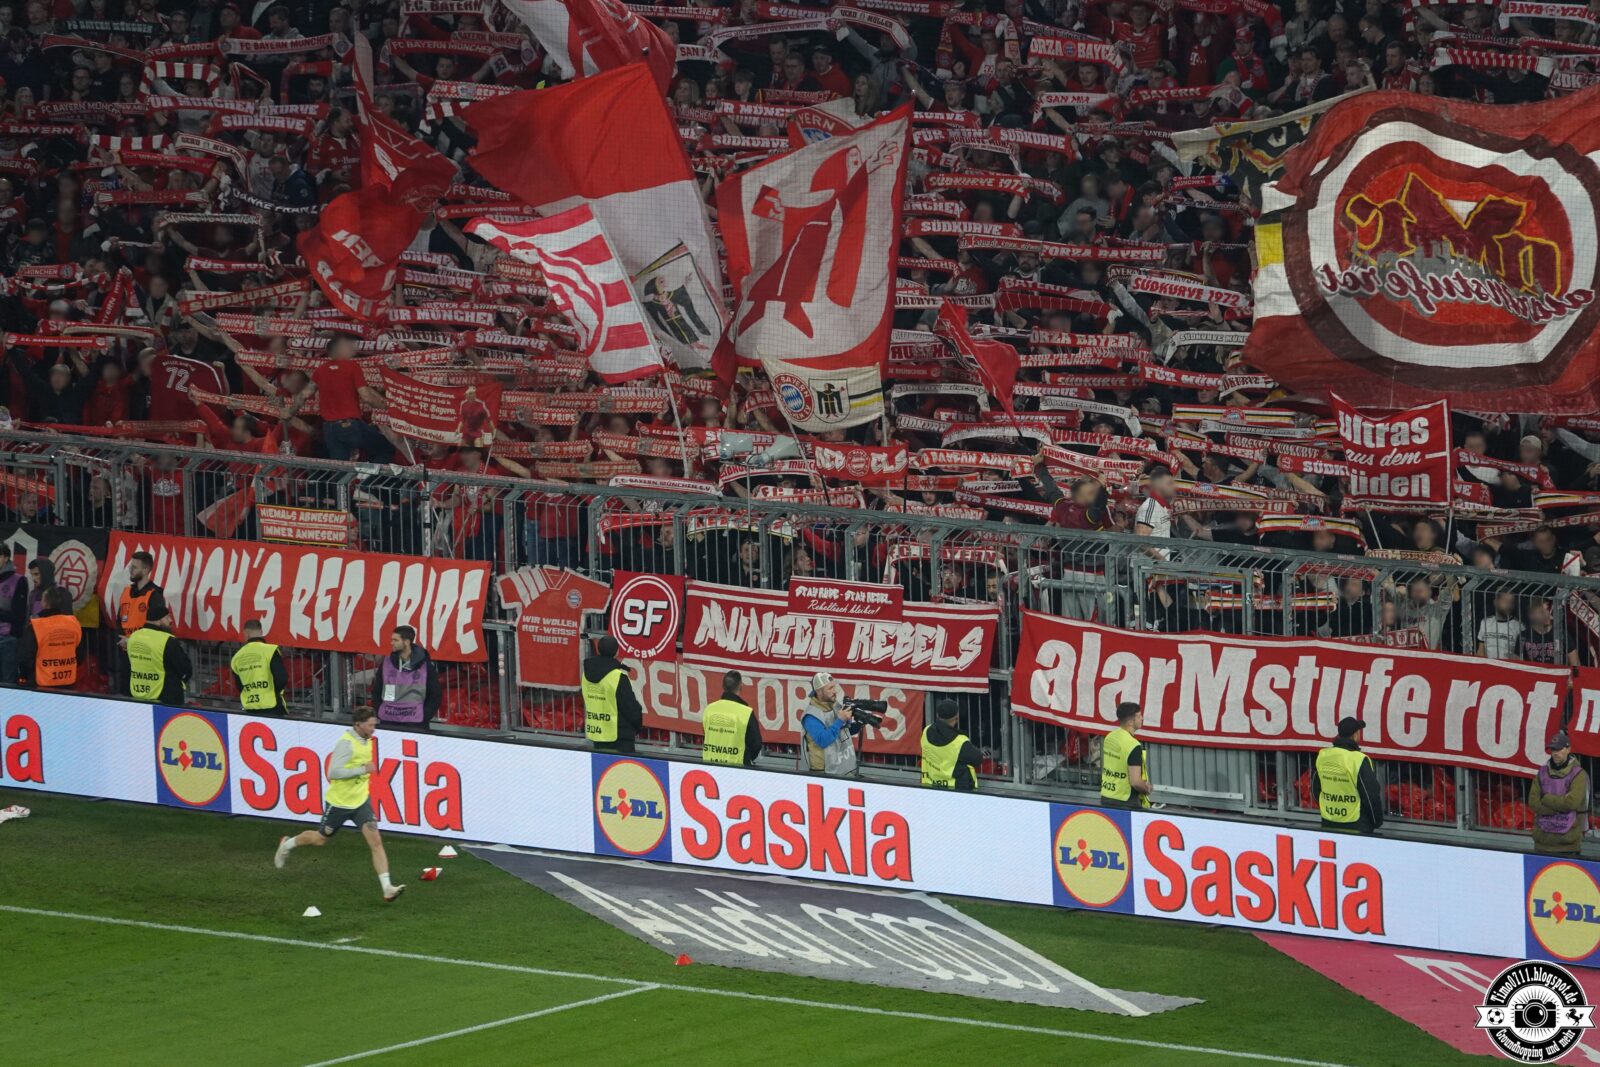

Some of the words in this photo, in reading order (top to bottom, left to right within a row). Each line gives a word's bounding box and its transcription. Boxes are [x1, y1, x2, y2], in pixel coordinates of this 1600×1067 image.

[798, 112, 836, 131] YERN
[166, 366, 189, 393] 72
[1380, 447, 1422, 467] dem
[1350, 468, 1431, 498] üden
[289, 552, 365, 643] RED
[373, 561, 485, 656] PRIDE
[522, 615, 540, 625] WIR
[542, 617, 578, 629] WOLLEN
[621, 598, 669, 637] SF
[521, 624, 577, 637] ROT-WEISSE
[532, 635, 569, 646] TRIKOTS
[626, 645, 658, 660] FCBM
[847, 621, 985, 672] REBELS
[52, 670, 72, 680] 1077
[1444, 679, 1559, 768] rot
[704, 744, 739, 756] STEWARD
[680, 769, 914, 883] Saskia
[1142, 819, 1386, 936] Saskia
